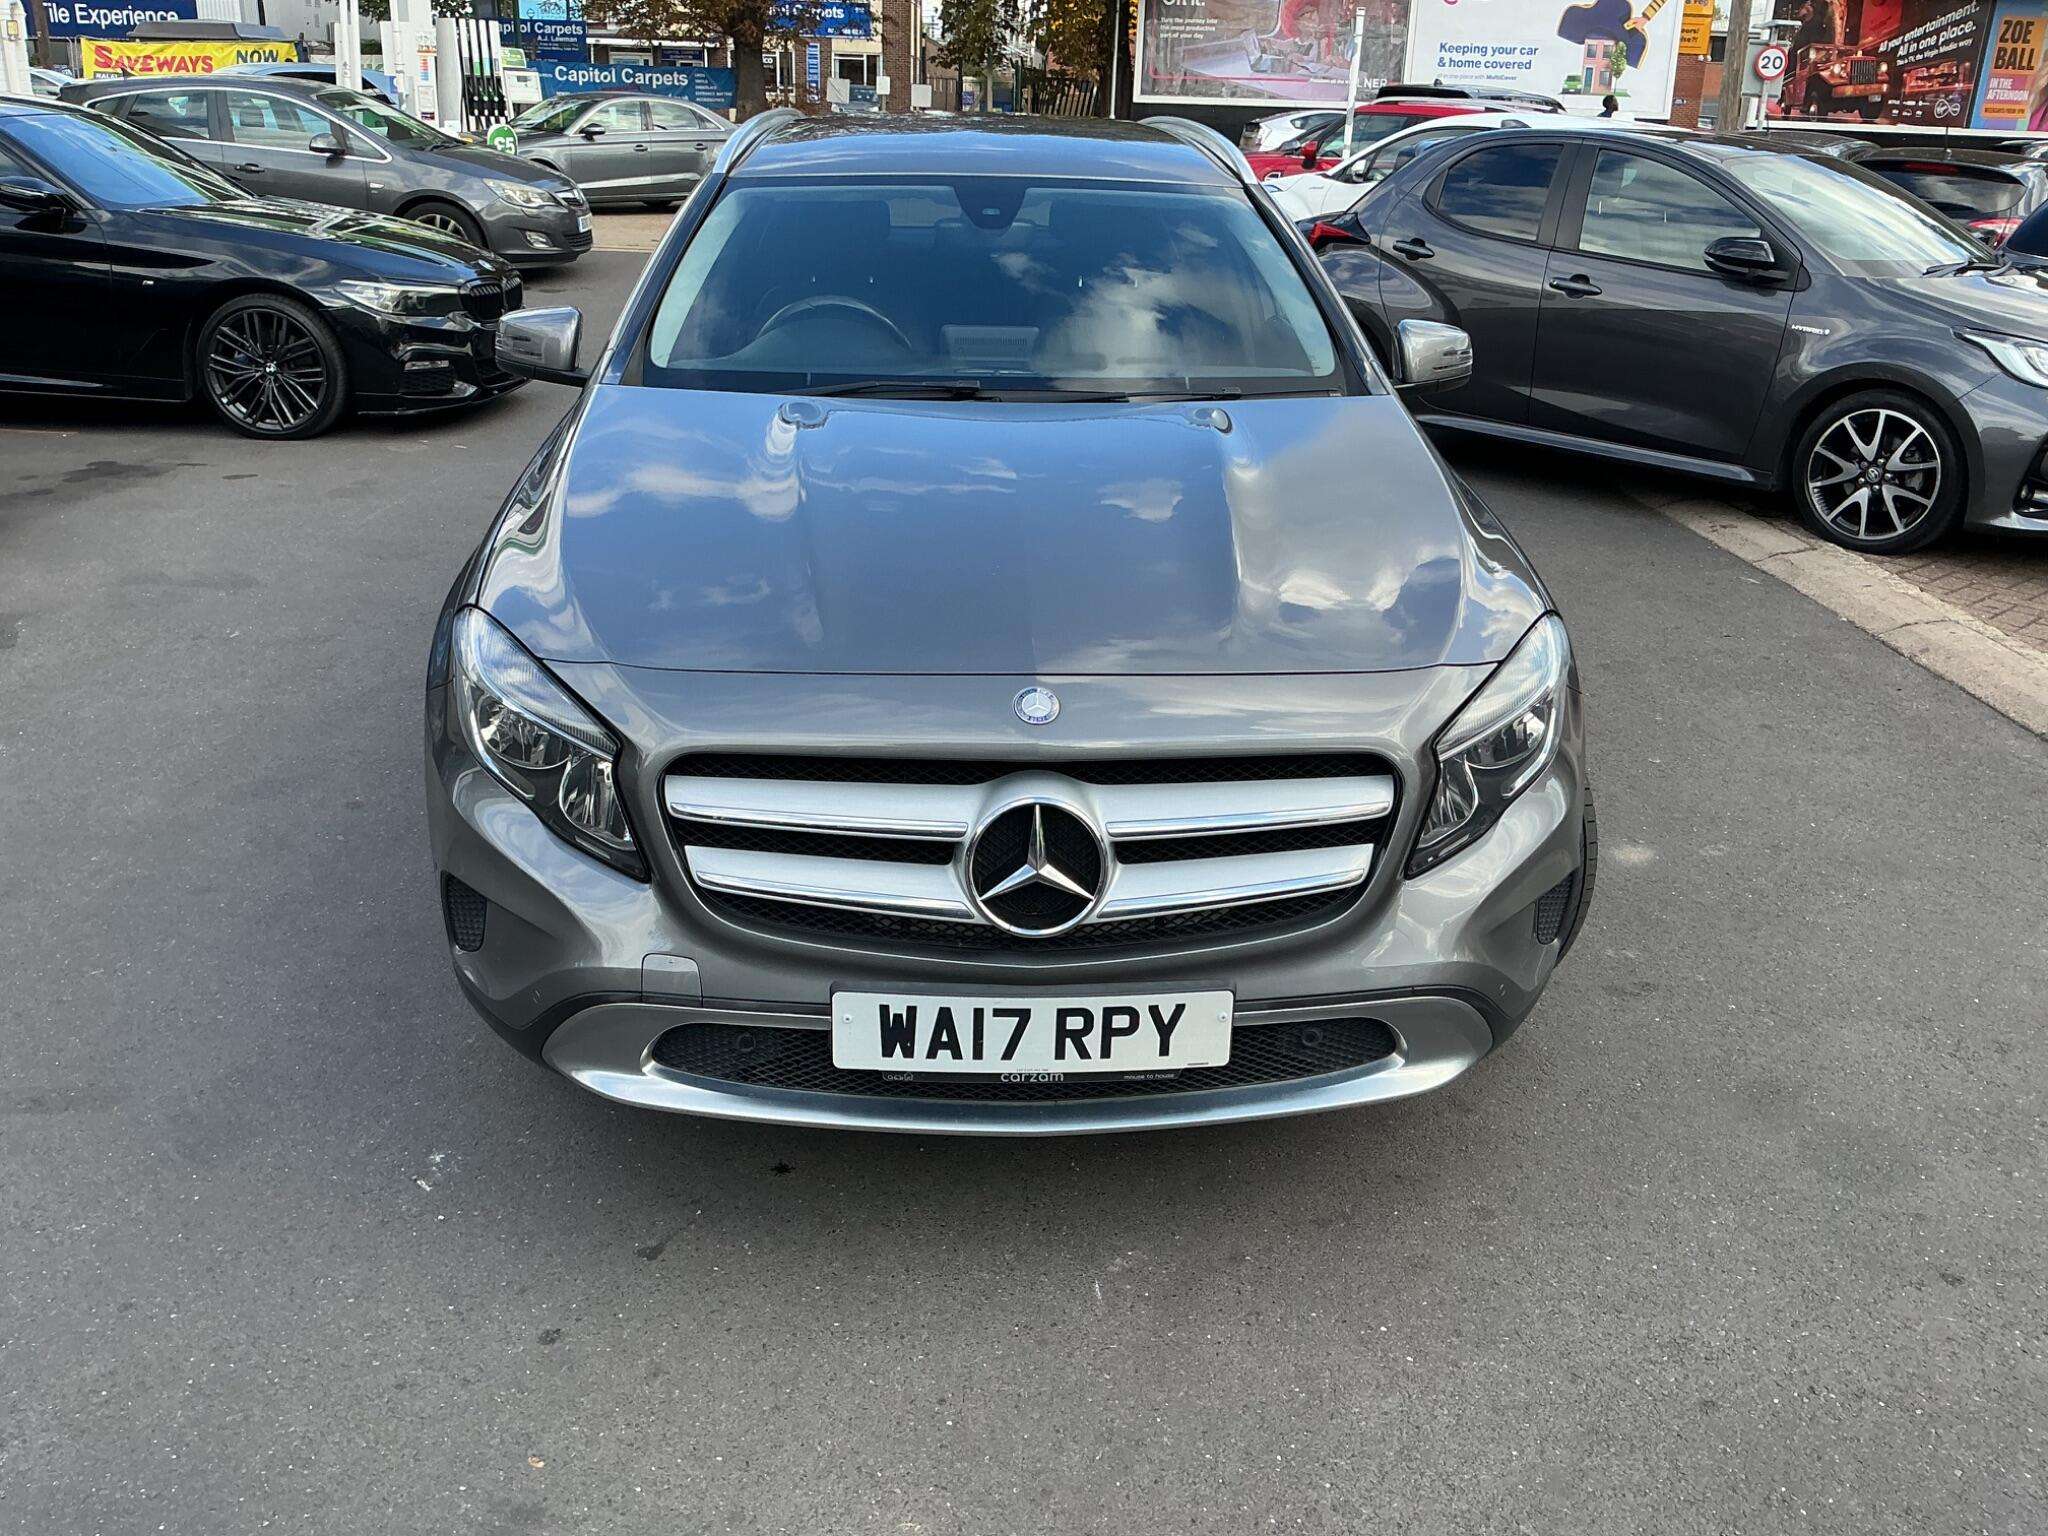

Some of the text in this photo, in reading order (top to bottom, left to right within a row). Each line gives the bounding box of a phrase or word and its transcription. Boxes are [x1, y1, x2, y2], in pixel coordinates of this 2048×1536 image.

[75, 3, 179, 29] Experience
[497, 21, 583, 36] apiol Carpets
[1878, 1, 1981, 54] All your entertainment.
[1999, 19, 2035, 44] ZOE
[1896, 20, 1977, 58] All in one place.
[1439, 42, 1539, 57] Keeping your car
[1924, 48, 1939, 60] Virgin
[1958, 37, 1973, 49] way
[236, 49, 279, 64] NOW
[1437, 57, 1532, 70] & home covered
[1761, 55, 1783, 70] 20
[1993, 46, 2035, 71] BALL
[554, 65, 689, 88] Capitol Carpets
[1357, 77, 1388, 88] LNER
[1989, 77, 2014, 89] IN THE
[1986, 88, 2030, 101] AFTERNOON
[878, 1003, 1186, 1061] WA17 RPY
[1000, 1071, 1064, 1082] carzam
